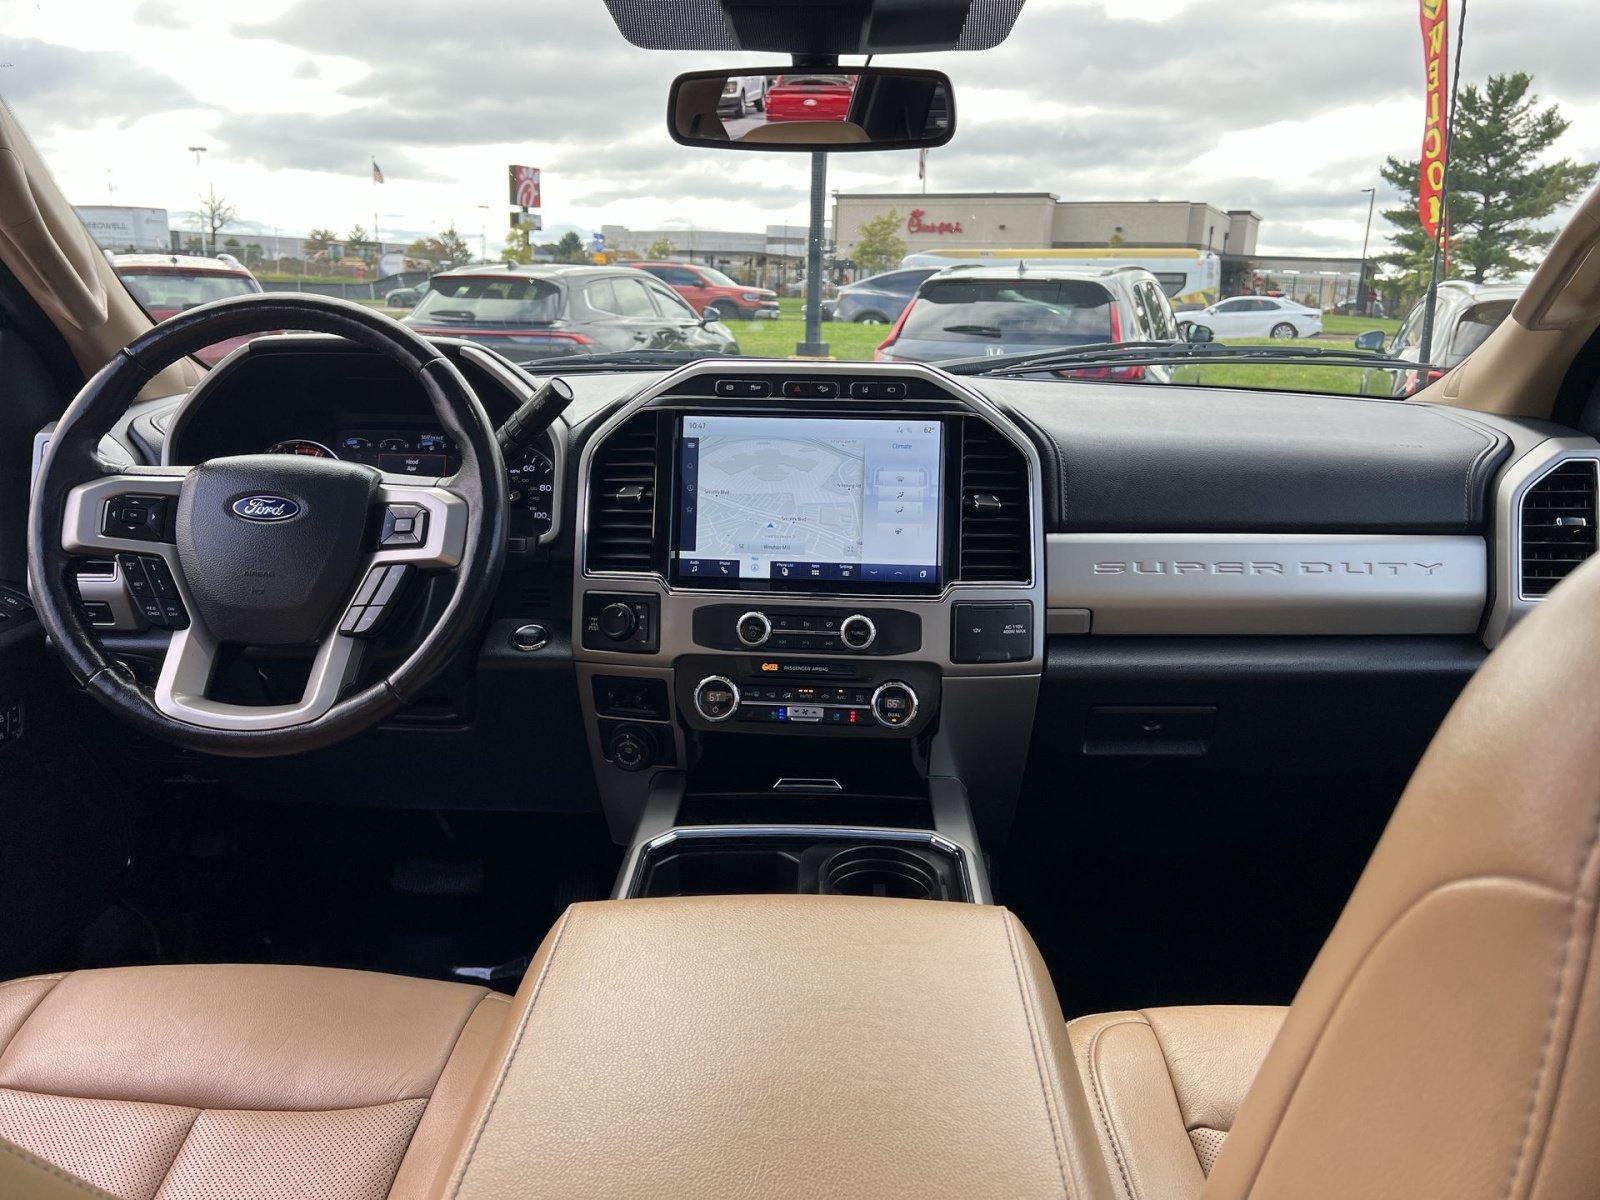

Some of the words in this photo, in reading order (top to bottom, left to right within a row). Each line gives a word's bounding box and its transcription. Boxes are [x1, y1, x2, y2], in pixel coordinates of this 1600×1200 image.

[689, 422, 706, 430] 10:47
[892, 442, 913, 450] Climate
[522, 465, 536, 473] 60
[539, 484, 552, 493] 80
[244, 498, 285, 517] Ford
[534, 511, 547, 519] 100
[1093, 561, 1283, 575] SUPER
[1298, 561, 1443, 576] DUTY
[244, 570, 276, 578] AIRBAG
